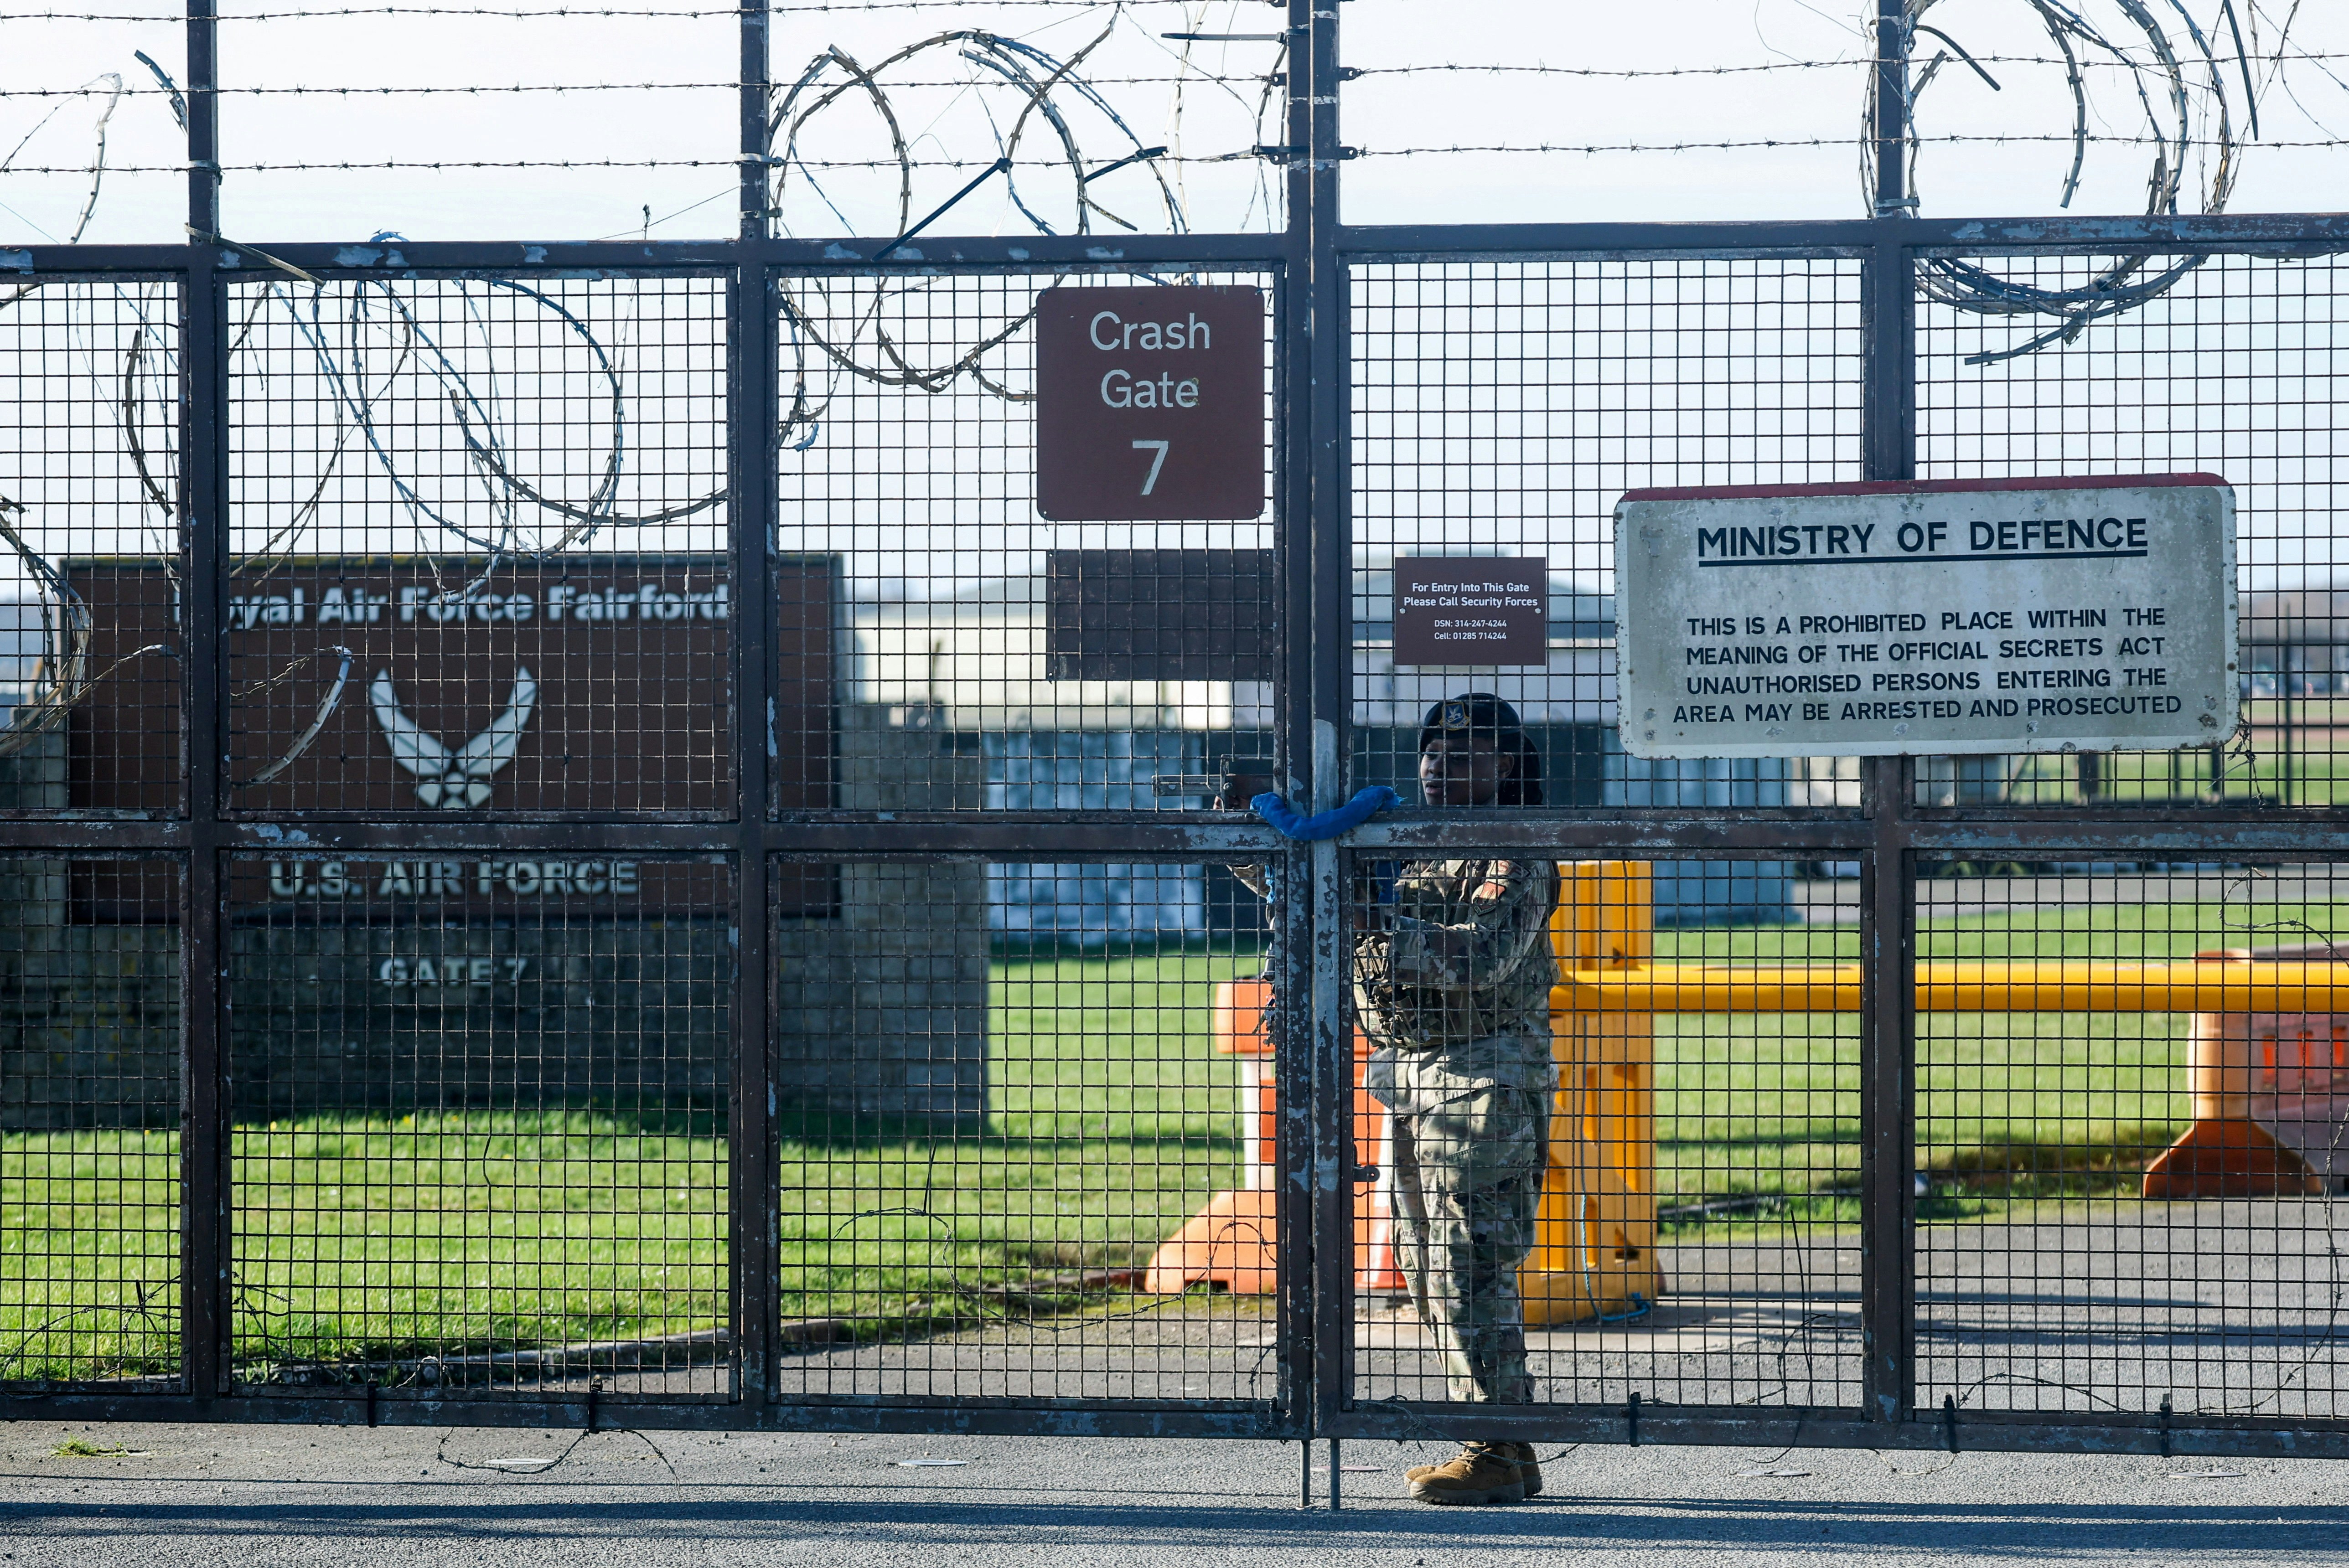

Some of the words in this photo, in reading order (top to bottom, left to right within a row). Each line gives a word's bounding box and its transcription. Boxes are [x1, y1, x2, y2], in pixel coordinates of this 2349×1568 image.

[1090, 311, 1210, 350] Crash
[1101, 369, 1199, 408] Gate
[1132, 439, 1169, 495] 7
[1697, 523, 1875, 557] MINISTRY
[1897, 521, 1947, 552] OF
[1970, 517, 2148, 551] DEFENCE
[1404, 597, 1436, 606] Please
[1439, 597, 1459, 606] Call
[1461, 597, 1502, 608] Security
[1505, 597, 1538, 606] Forces
[1413, 583, 1429, 592] For
[1432, 583, 1458, 594] Entry
[1461, 583, 1480, 592] Into
[1482, 582, 1504, 592] This
[1506, 582, 1529, 592] Gate
[174, 587, 304, 629] yal
[318, 587, 388, 623] Air
[400, 586, 535, 623] Force
[547, 583, 729, 621] Fairford
[1687, 618, 1736, 635] THIS
[1746, 616, 1765, 634] IS
[1775, 616, 1791, 634] A
[1800, 614, 1926, 634] PROHIBITED
[1942, 611, 2013, 630] PLACE
[2028, 609, 2106, 629] WITHIN
[2122, 608, 2166, 626] THE
[1687, 645, 1788, 665] MEANING
[1798, 645, 1827, 664] OF
[1837, 644, 1879, 662] THE
[1889, 641, 1988, 661] OFFICIAL
[1999, 638, 2103, 658] SECRETS
[2118, 637, 2165, 655] ACT
[1687, 674, 1861, 695] UNAUTHORISED
[1873, 671, 1980, 691] PERSONS
[1997, 668, 2111, 689] ENTERING
[2123, 668, 2167, 686] THE
[1673, 705, 1735, 723] AREA
[1745, 703, 1793, 722] MAY
[1803, 703, 1830, 721] BE
[1840, 700, 1961, 720] ARRESTED
[1969, 699, 2019, 717] AND
[2027, 696, 2182, 717] PROSECUTED
[270, 861, 363, 897] U.S.
[378, 861, 465, 896] AIR
[477, 861, 639, 896] FORCE
[379, 957, 497, 987] GATE
[504, 957, 528, 987] 7
